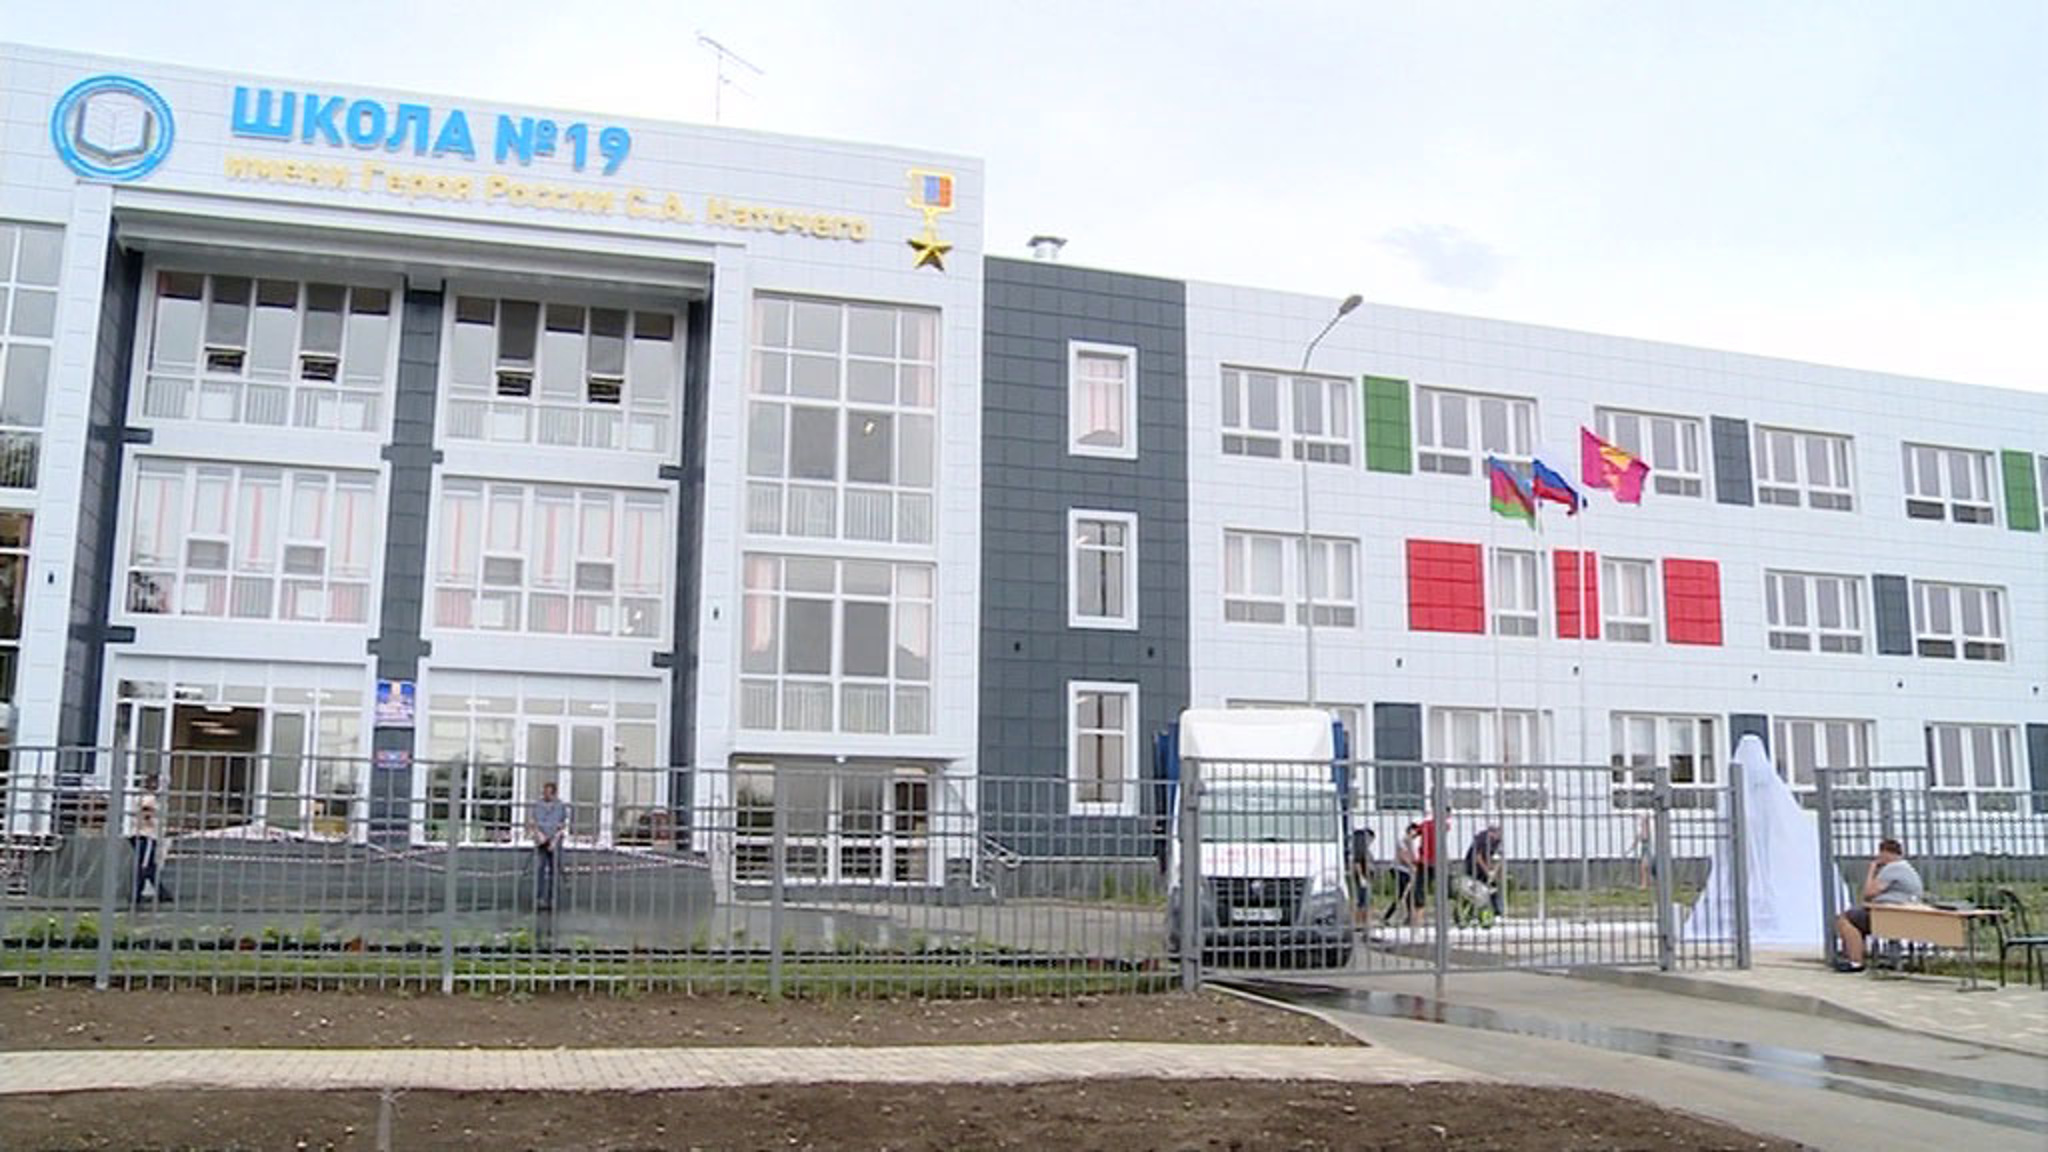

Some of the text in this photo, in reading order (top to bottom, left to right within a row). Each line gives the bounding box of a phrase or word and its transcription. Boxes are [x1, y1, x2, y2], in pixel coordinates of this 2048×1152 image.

[232, 86, 632, 176] ШКОЛА №19
[226, 157, 872, 242] имени Героя России С.А. Наточего
